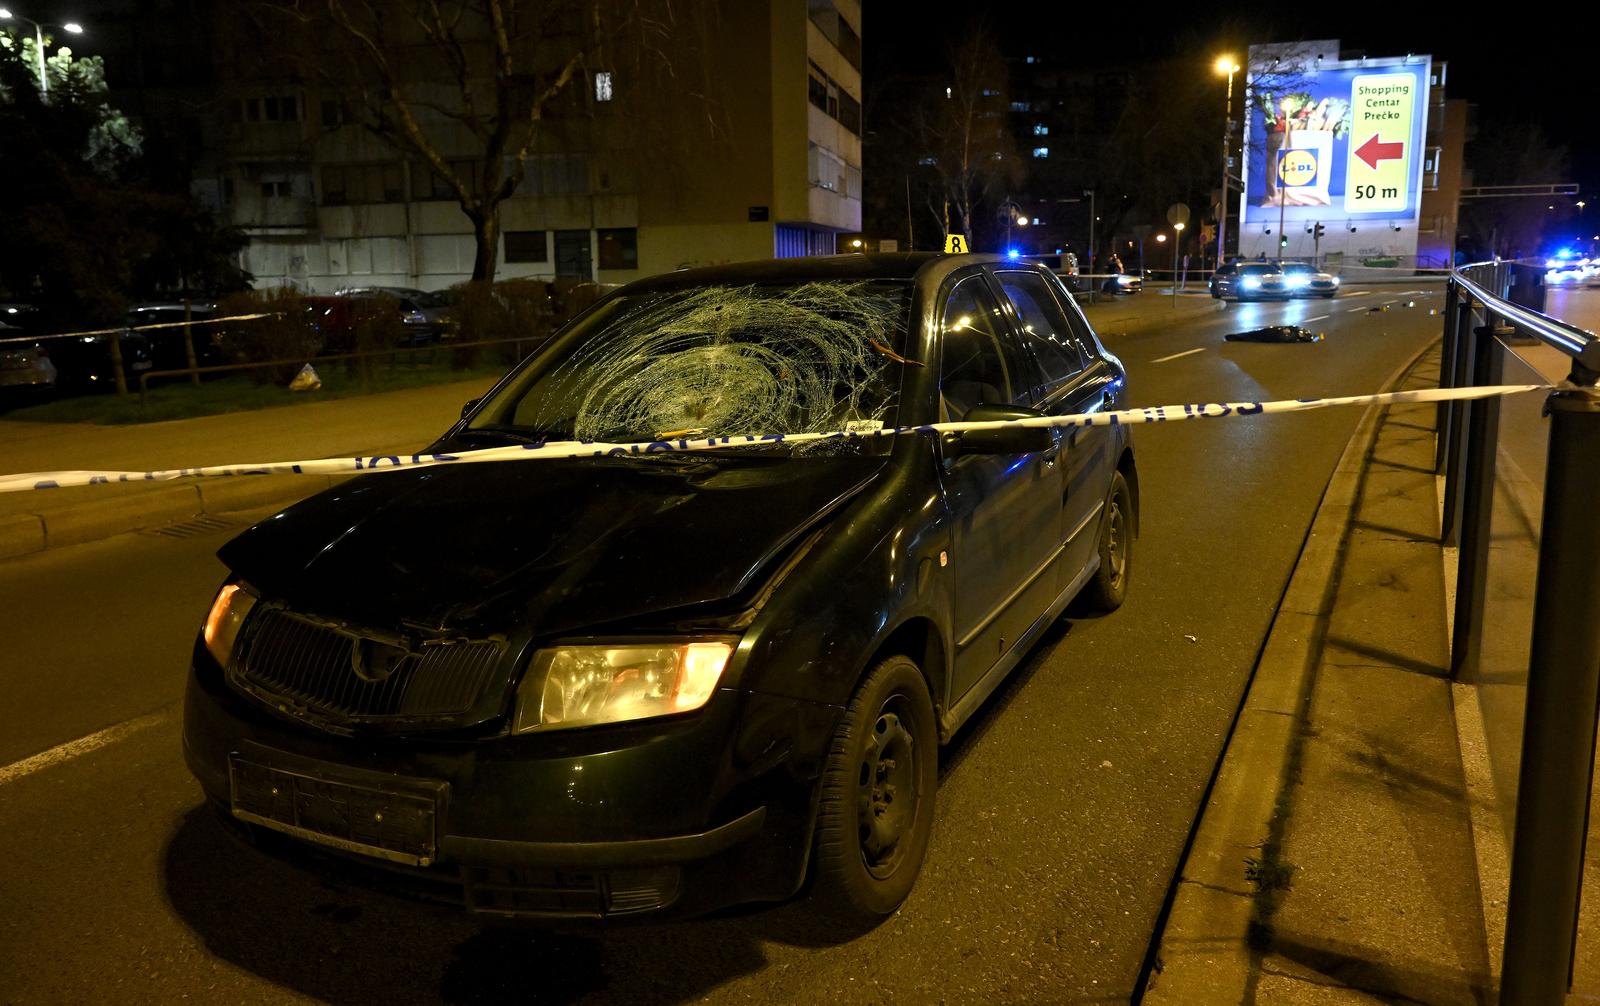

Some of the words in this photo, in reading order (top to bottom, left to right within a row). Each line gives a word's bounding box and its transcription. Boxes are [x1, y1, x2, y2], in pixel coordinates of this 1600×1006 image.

[1359, 84, 1409, 95] Shopping
[1366, 98, 1400, 107] Centar
[1364, 111, 1400, 120] Prečko
[1355, 184, 1376, 199] 50
[1382, 187, 1398, 198] m
[952, 236, 962, 252] 8
